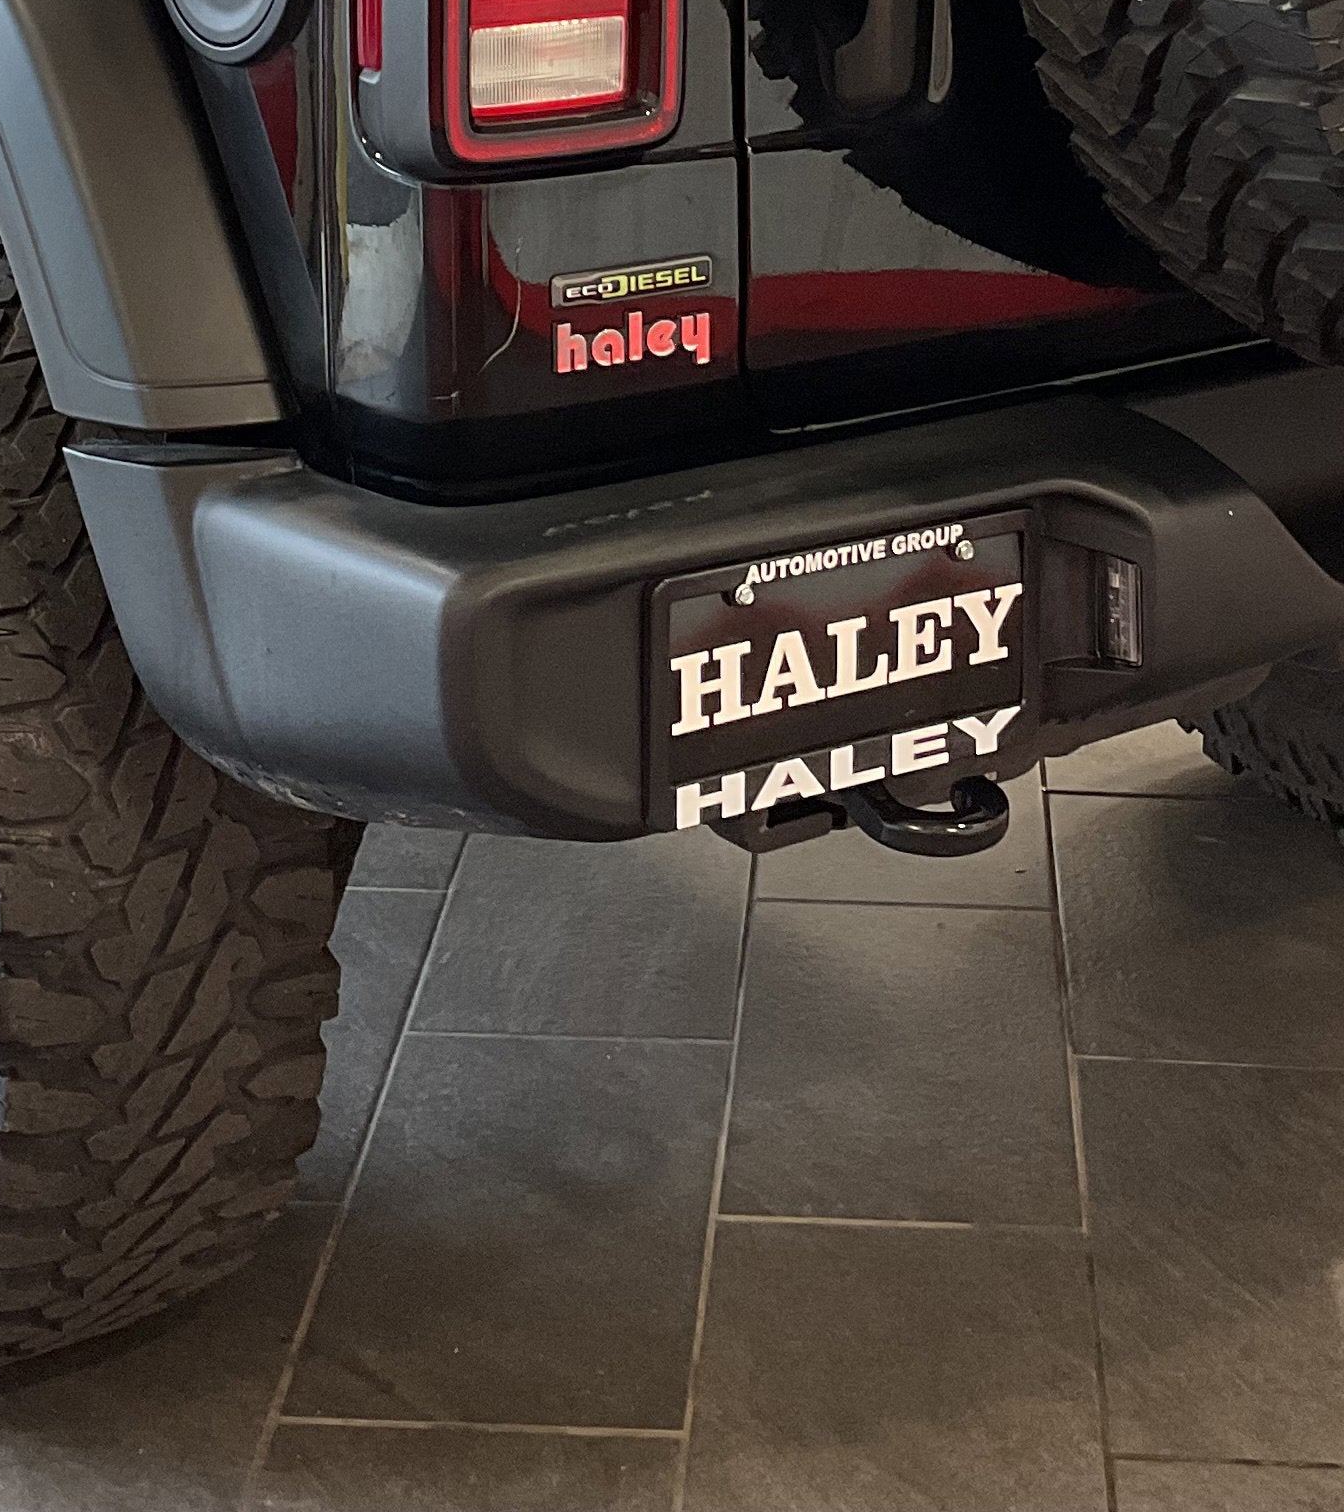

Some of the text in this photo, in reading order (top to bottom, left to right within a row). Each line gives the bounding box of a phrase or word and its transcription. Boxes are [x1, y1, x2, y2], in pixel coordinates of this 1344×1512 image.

[556, 310, 711, 374] haley
[744, 522, 964, 585] AUTOMOTIVE GROUP
[669, 582, 1024, 737] HALEY
[675, 704, 1023, 830] HALEY
